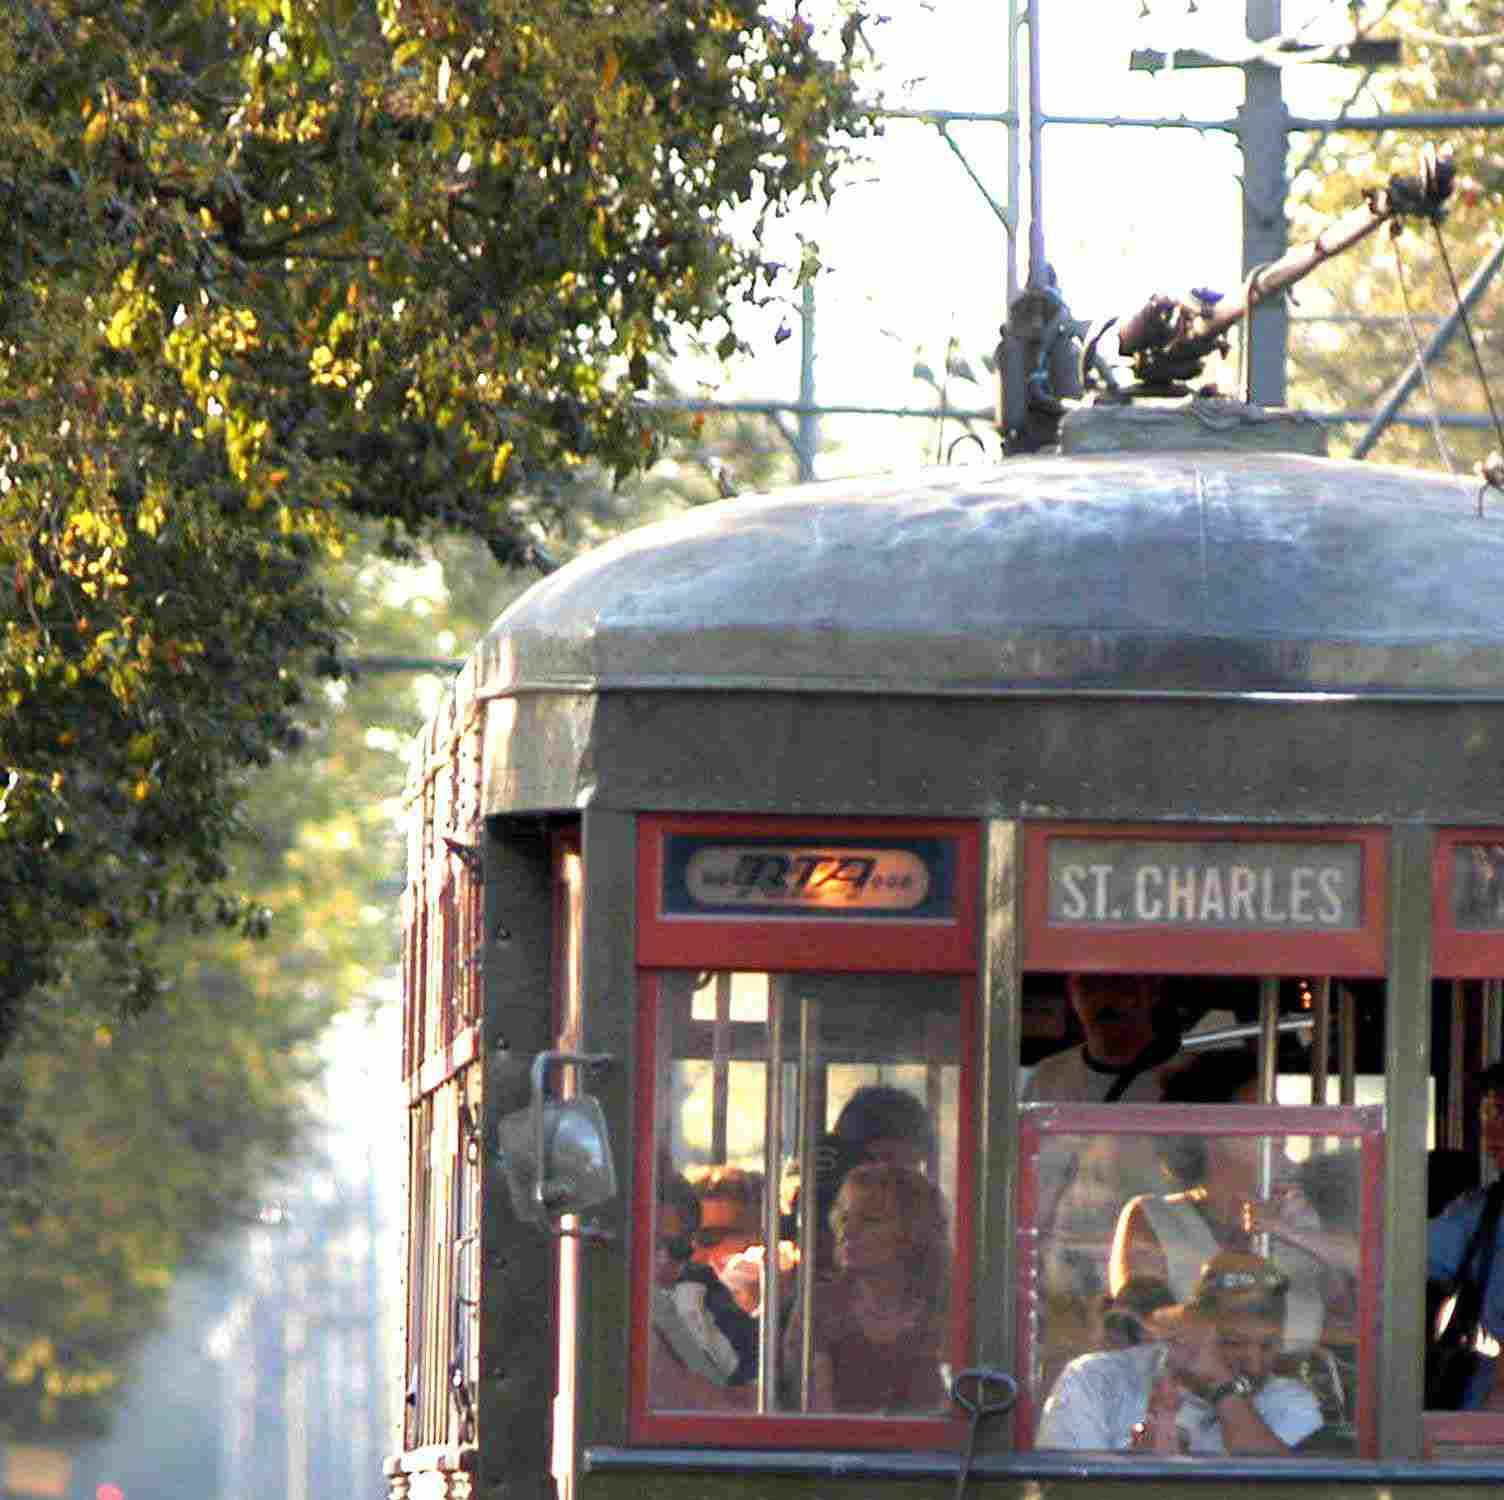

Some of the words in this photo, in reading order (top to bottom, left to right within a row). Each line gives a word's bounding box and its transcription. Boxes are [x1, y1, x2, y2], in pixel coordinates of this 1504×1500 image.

[729, 854, 879, 898] RTA
[1058, 863, 1123, 921] ST.
[1134, 863, 1347, 924] CHARLES
